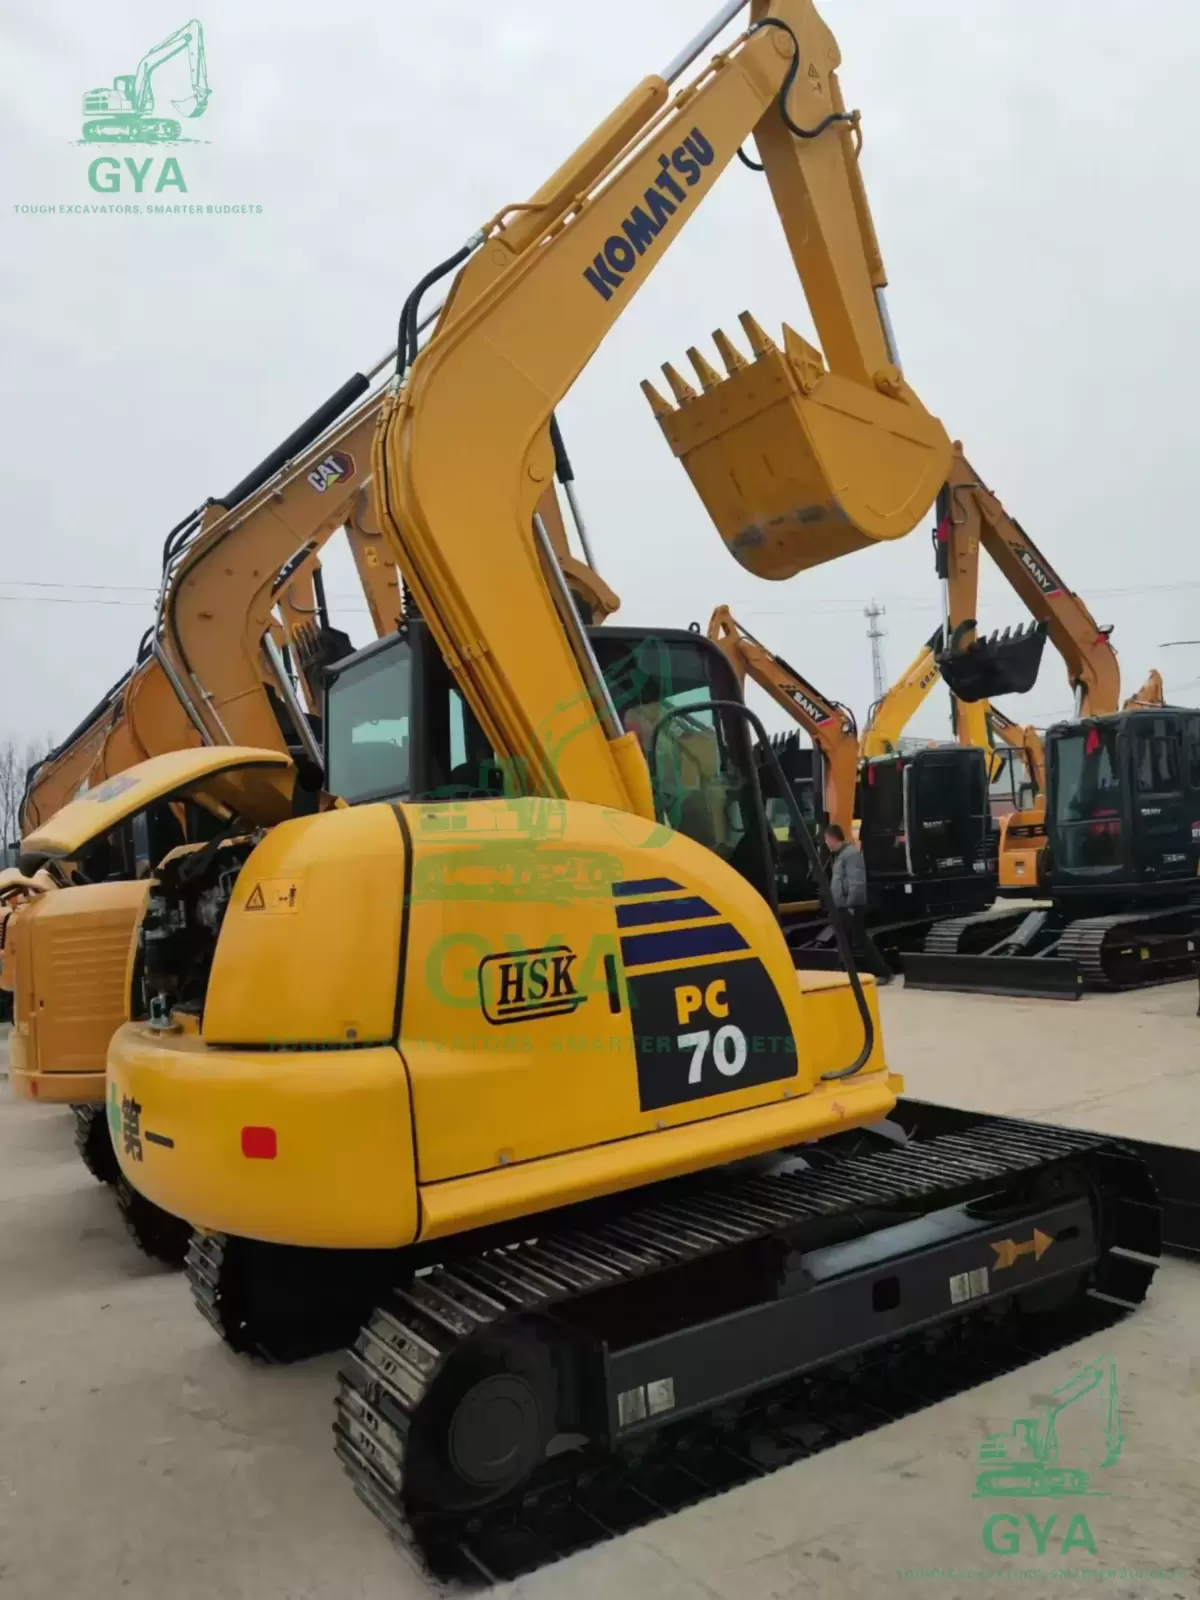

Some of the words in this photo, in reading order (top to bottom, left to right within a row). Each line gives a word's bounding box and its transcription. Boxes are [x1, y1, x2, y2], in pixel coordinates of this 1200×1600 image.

[582, 126, 715, 302] KOMATSU
[307, 455, 345, 492] CAT
[1021, 552, 1051, 588] SANY
[793, 691, 823, 721] SANY
[497, 953, 579, 1006] HSK
[674, 979, 730, 1025] PC
[676, 1024, 748, 1085] 70
